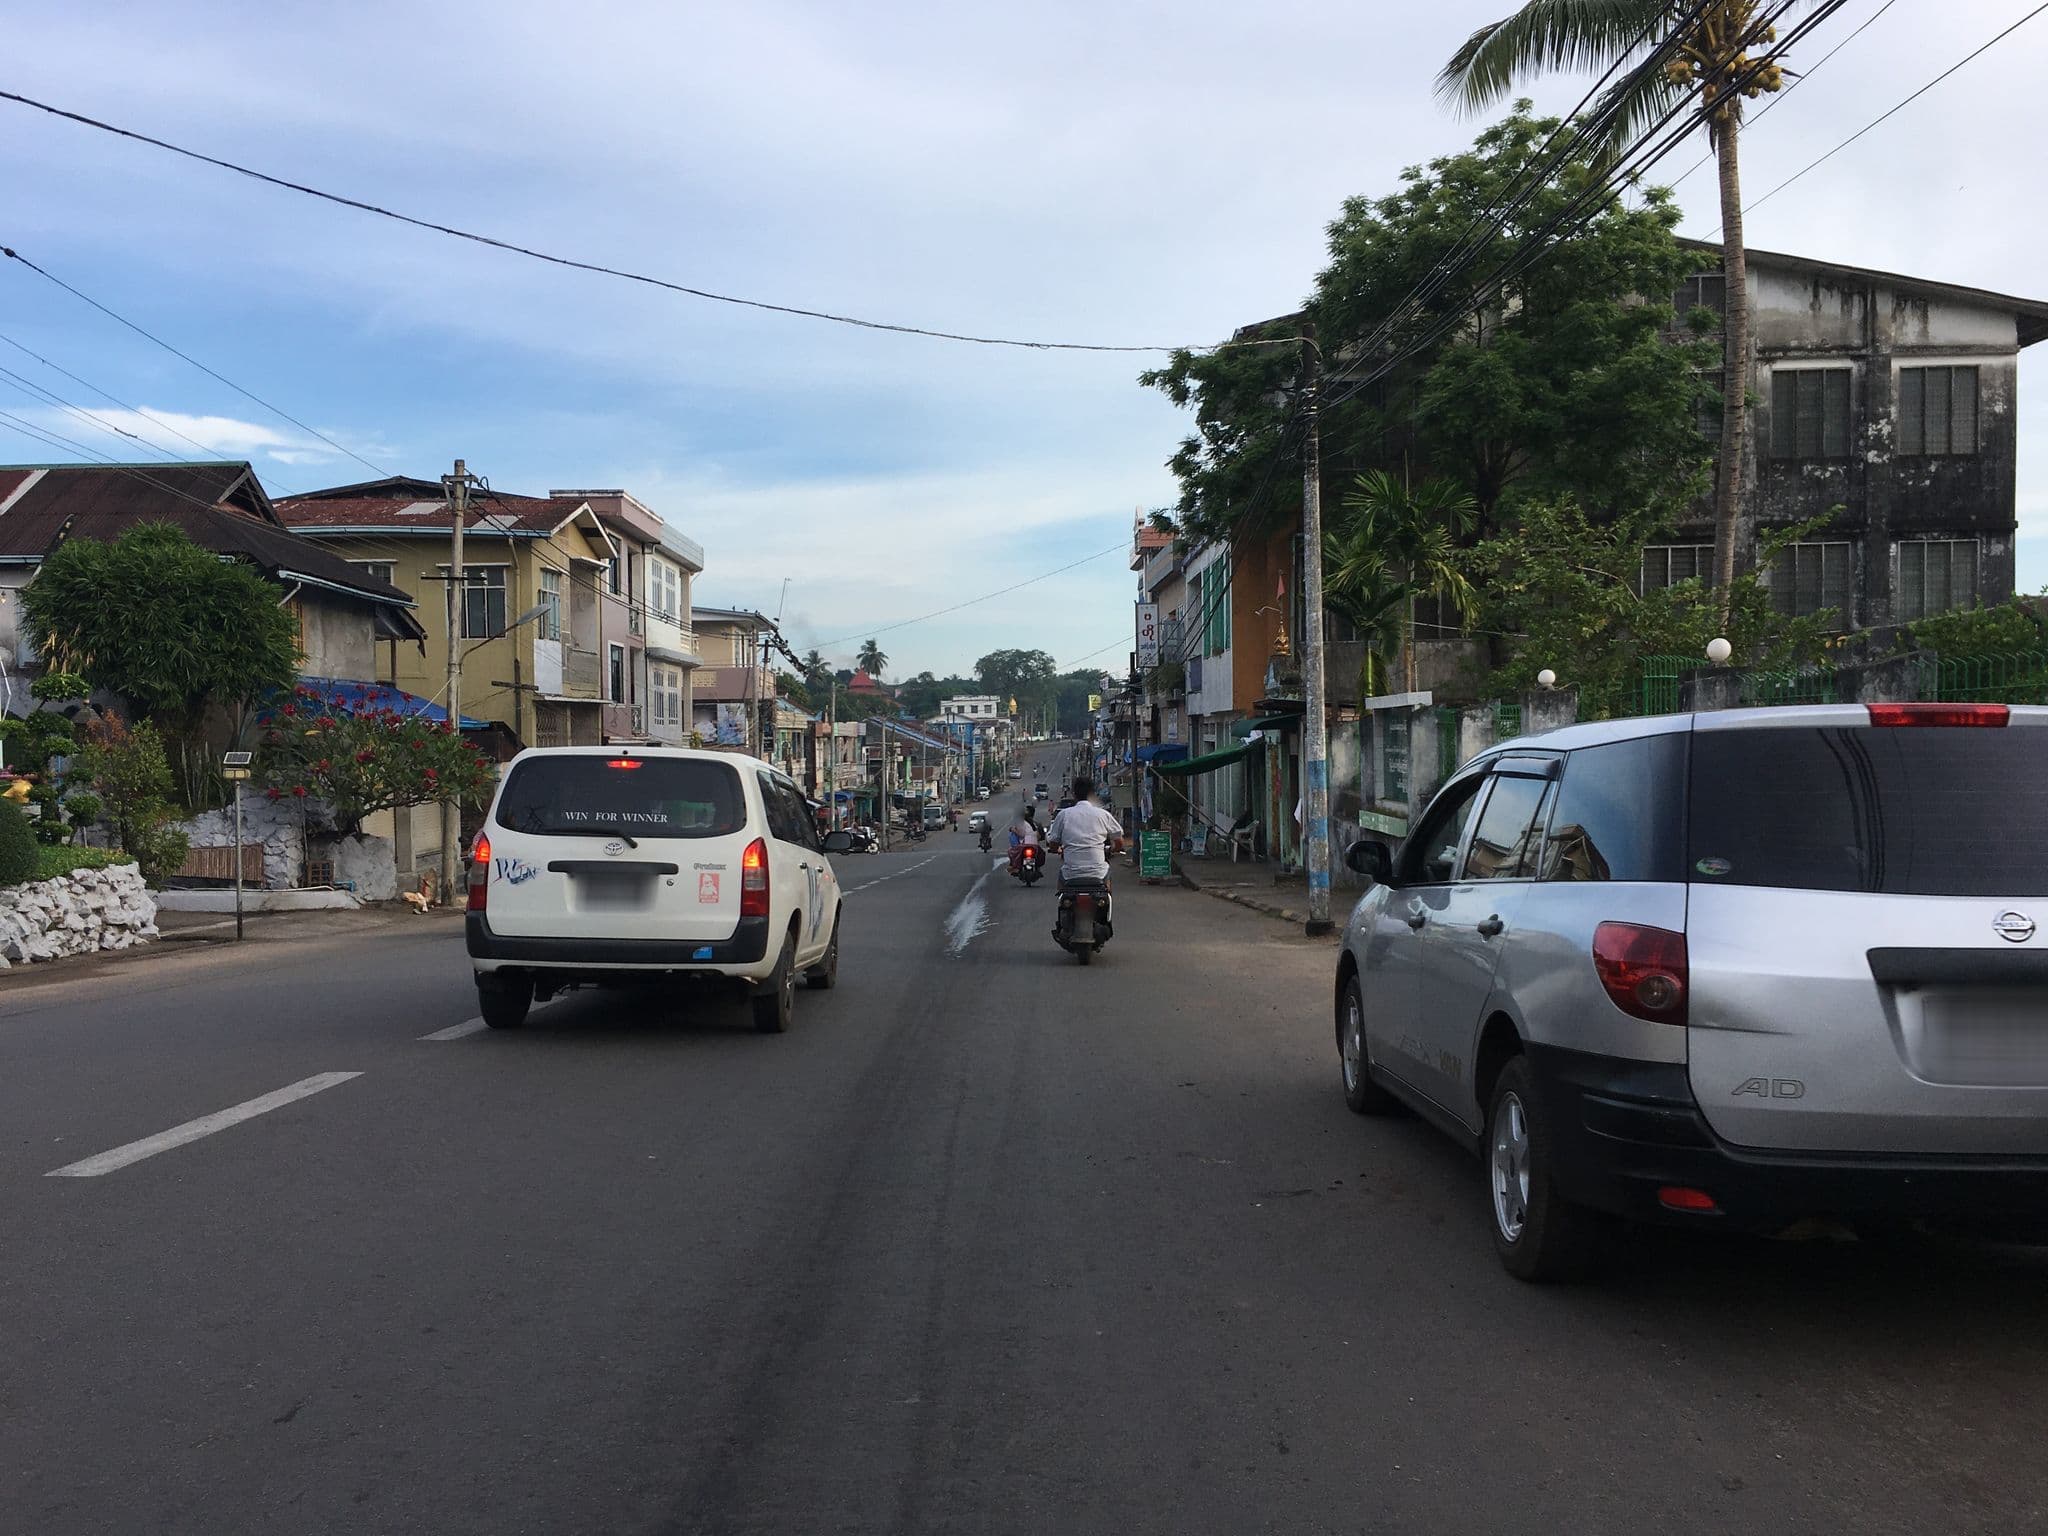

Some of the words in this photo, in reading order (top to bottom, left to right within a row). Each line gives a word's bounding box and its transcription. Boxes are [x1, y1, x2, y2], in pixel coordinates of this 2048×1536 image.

[565, 811, 589, 821] WIN
[595, 812, 618, 821] FOR
[622, 813, 668, 823] WINNER
[1731, 1077, 1806, 1099] AD
